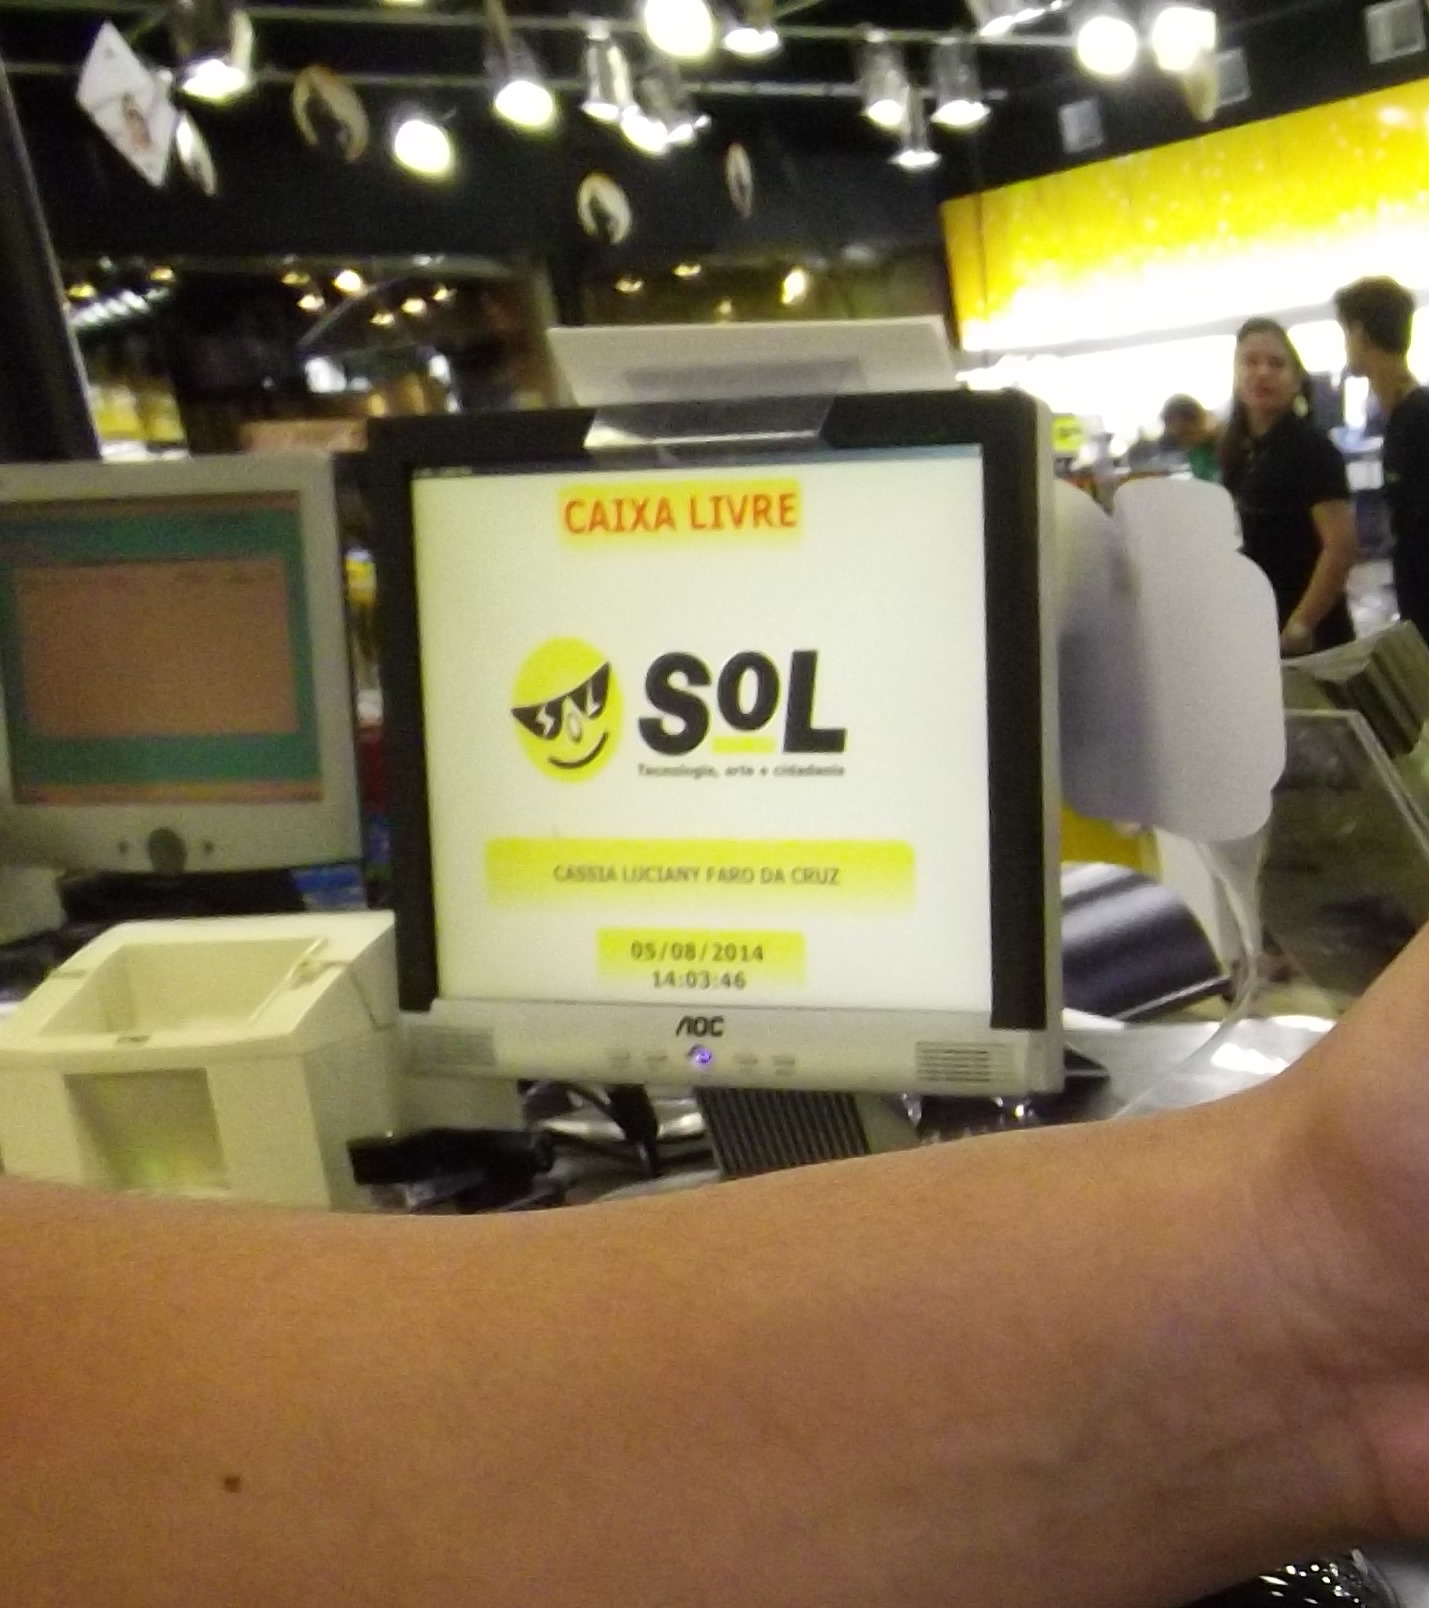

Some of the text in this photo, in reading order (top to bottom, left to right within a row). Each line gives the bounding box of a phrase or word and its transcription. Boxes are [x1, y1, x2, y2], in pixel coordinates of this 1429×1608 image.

[563, 492, 797, 536] CAIXA LIVRE
[638, 648, 846, 755] SOL
[725, 765, 755, 777] arte
[553, 864, 841, 885] CASSIA LUCIANY FARO DA CRUZ
[630, 941, 764, 963] 05/08/2014
[652, 970, 746, 991] 14:03:46
[676, 1016, 724, 1038] AOC
